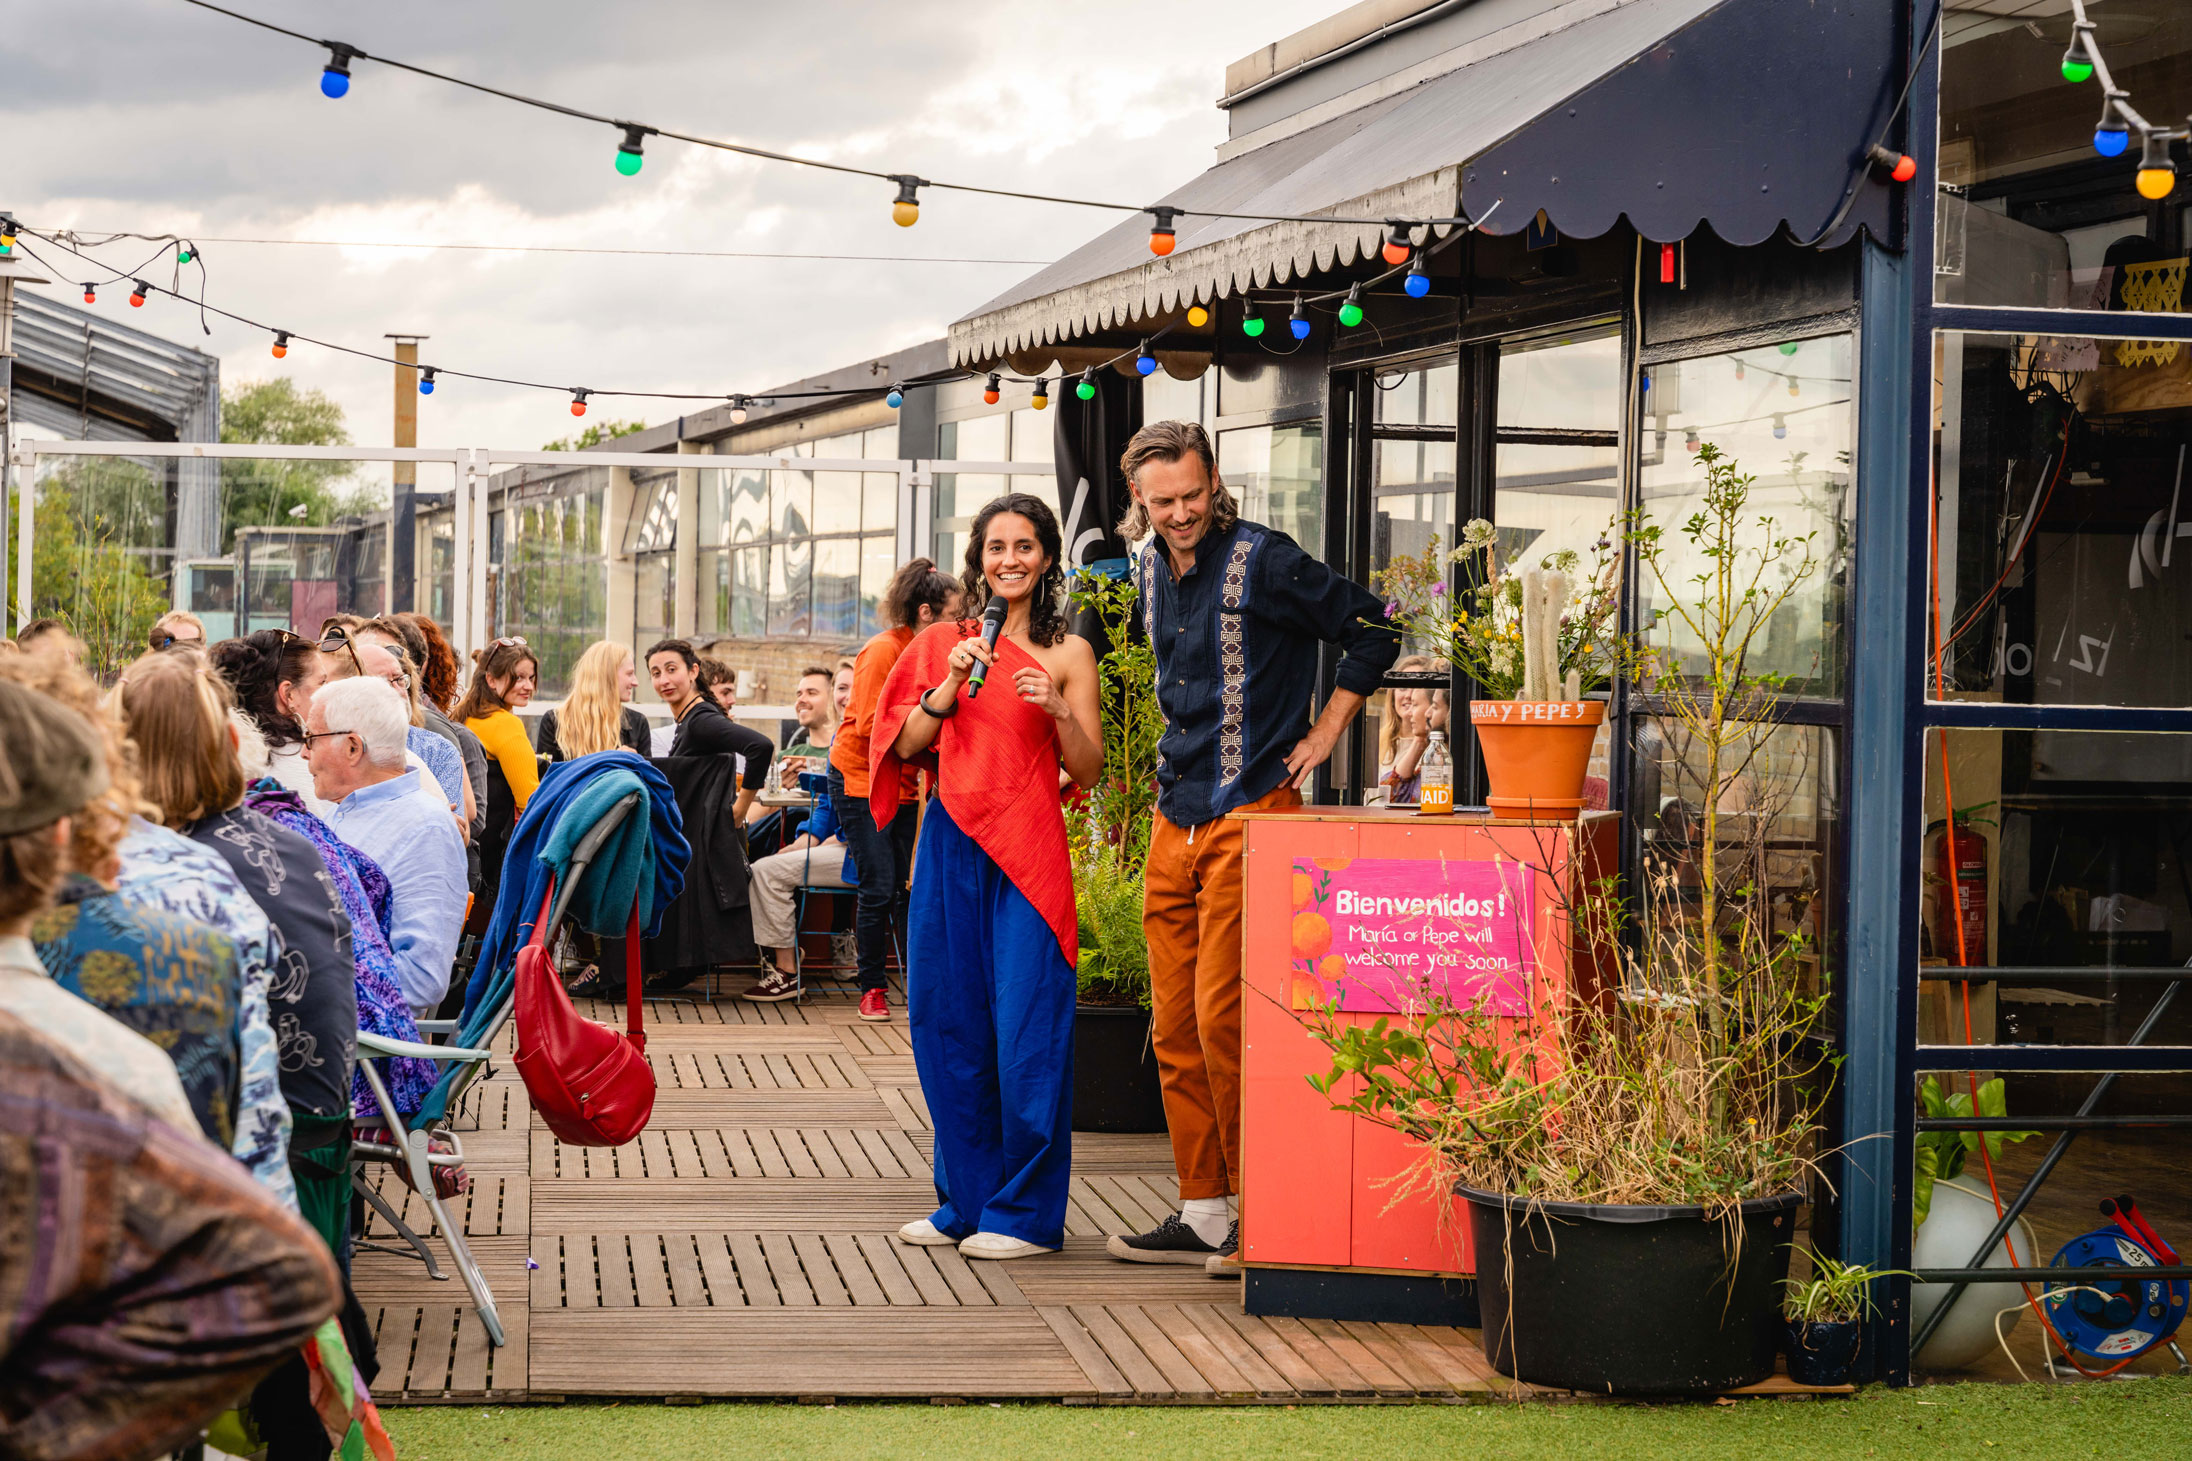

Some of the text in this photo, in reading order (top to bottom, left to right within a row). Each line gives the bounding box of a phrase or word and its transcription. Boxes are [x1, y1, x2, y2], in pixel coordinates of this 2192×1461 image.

[1336, 889, 1506, 918] Bienvenidos!
[1349, 924, 1398, 943] María
[1422, 925, 1460, 949] Pepe
[1464, 927, 1493, 943] will
[1344, 946, 1420, 967] welcome
[1424, 952, 1458, 974] you
[2128, 1248, 2144, 1262] 25
